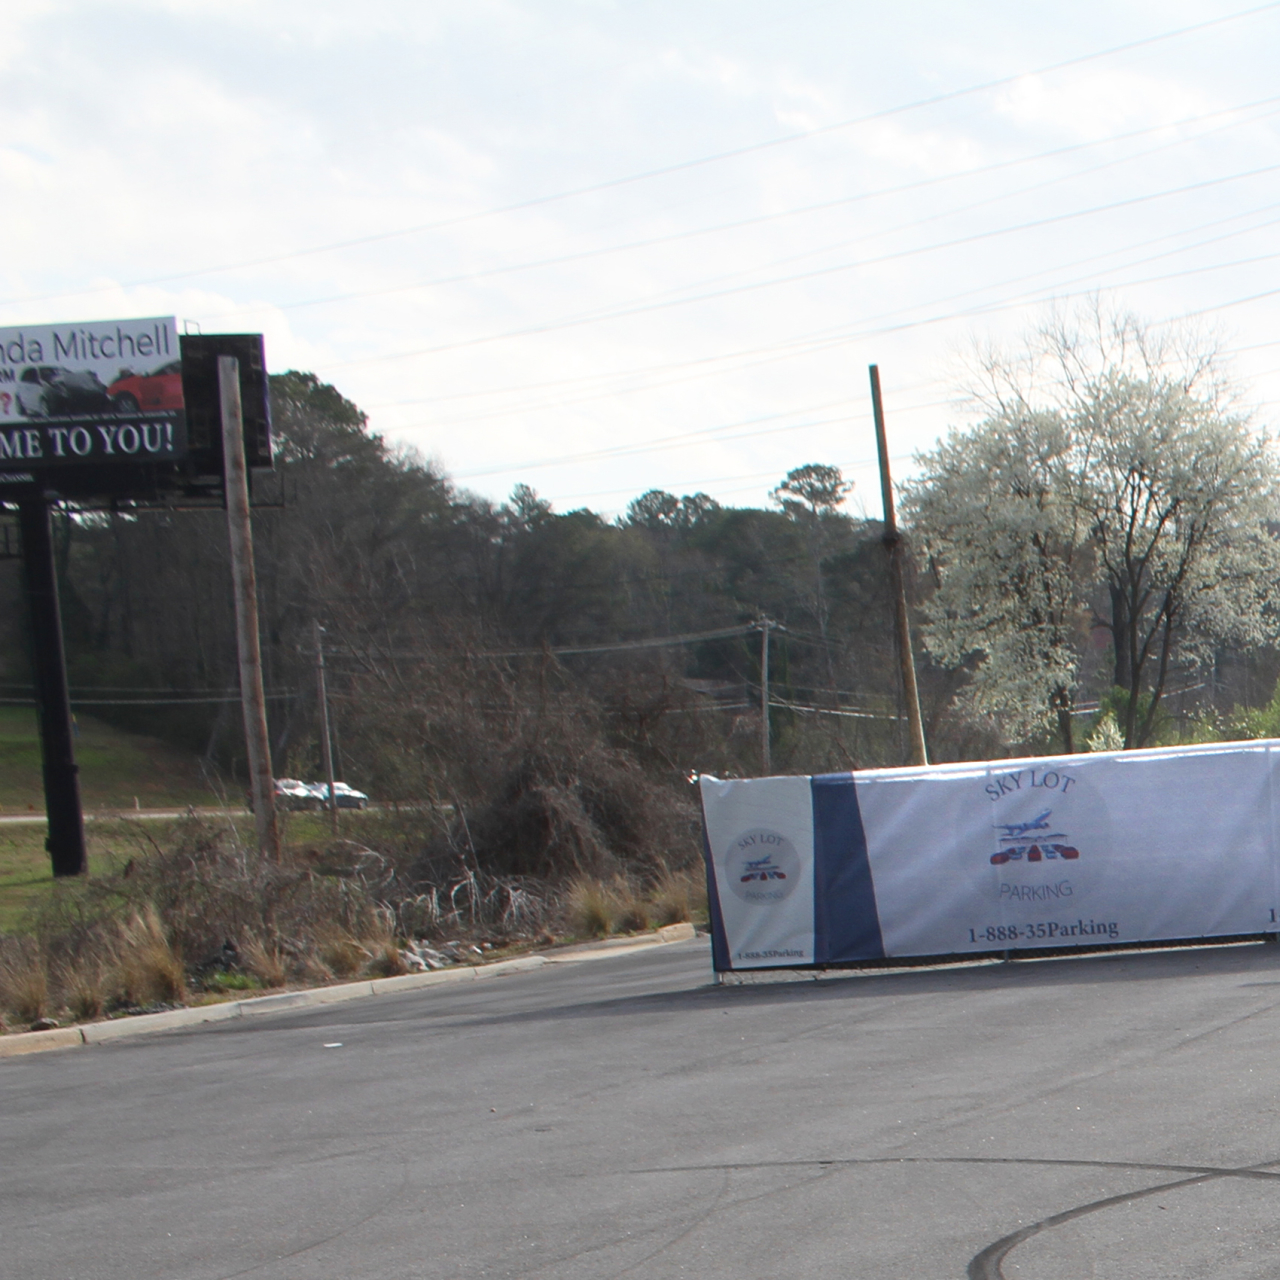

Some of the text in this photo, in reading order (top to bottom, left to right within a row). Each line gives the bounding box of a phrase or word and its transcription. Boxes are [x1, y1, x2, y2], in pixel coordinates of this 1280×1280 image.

[53, 323, 170, 361] Mitchell
[48, 426, 92, 456] TO
[97, 422, 173, 455] YOU!
[985, 769, 1076, 802] SKY LOT
[737, 833, 785, 850] SKY LOT
[999, 880, 1073, 901] PARKING
[968, 918, 1119, 944] 1-888-35Parking
